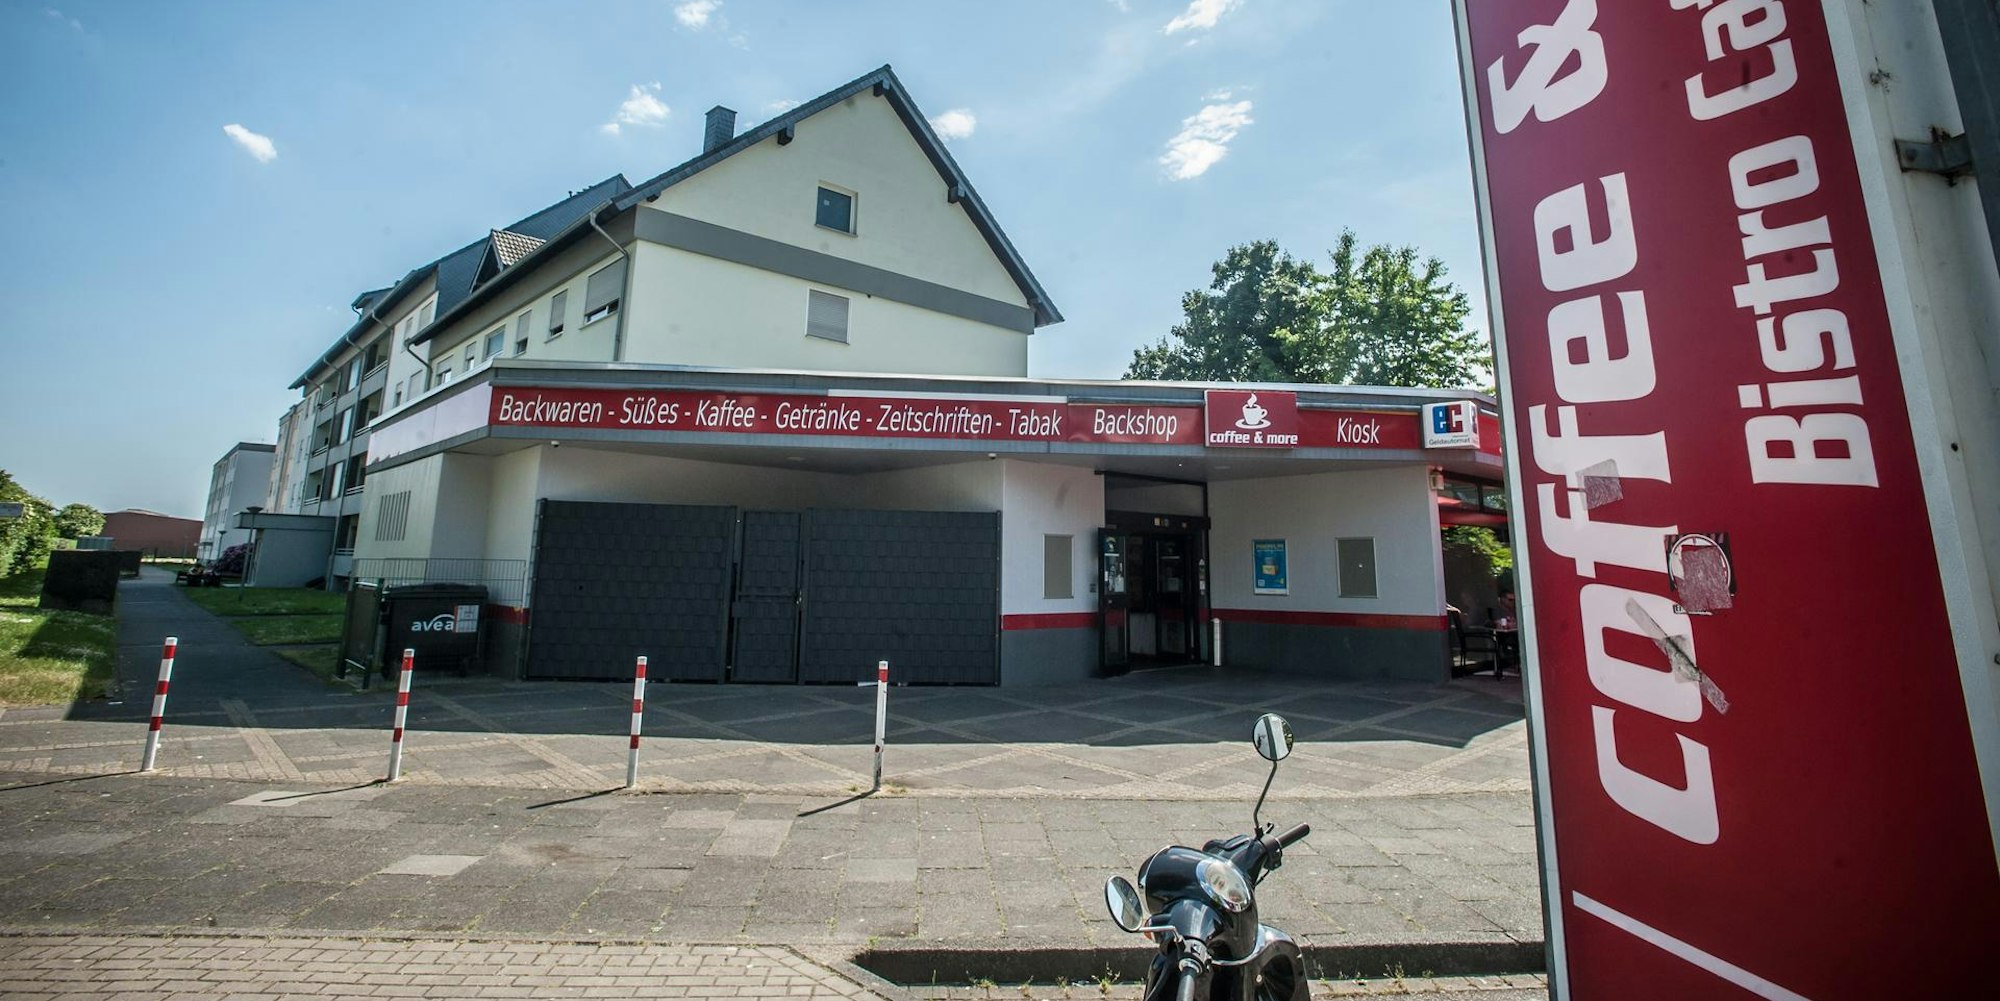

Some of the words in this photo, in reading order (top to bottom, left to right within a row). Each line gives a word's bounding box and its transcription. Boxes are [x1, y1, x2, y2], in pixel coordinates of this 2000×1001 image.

[1487, 0, 1609, 135] &
[1728, 135, 1880, 488] Bistro
[499, 394, 602, 423] Backwaren
[619, 396, 680, 425] Süßes
[695, 399, 756, 428] Kaffee
[775, 402, 861, 431] Getränke
[1008, 408, 1063, 436] Tabak
[1093, 408, 1178, 442] Backshop
[1337, 417, 1380, 444] Kiosk
[1209, 430, 1250, 444] coffee
[1253, 430, 1264, 444] &
[1266, 434, 1299, 445] more
[1429, 438, 1470, 446] Geldautomat
[1529, 171, 1721, 845] coffee
[411, 613, 455, 632] avea
